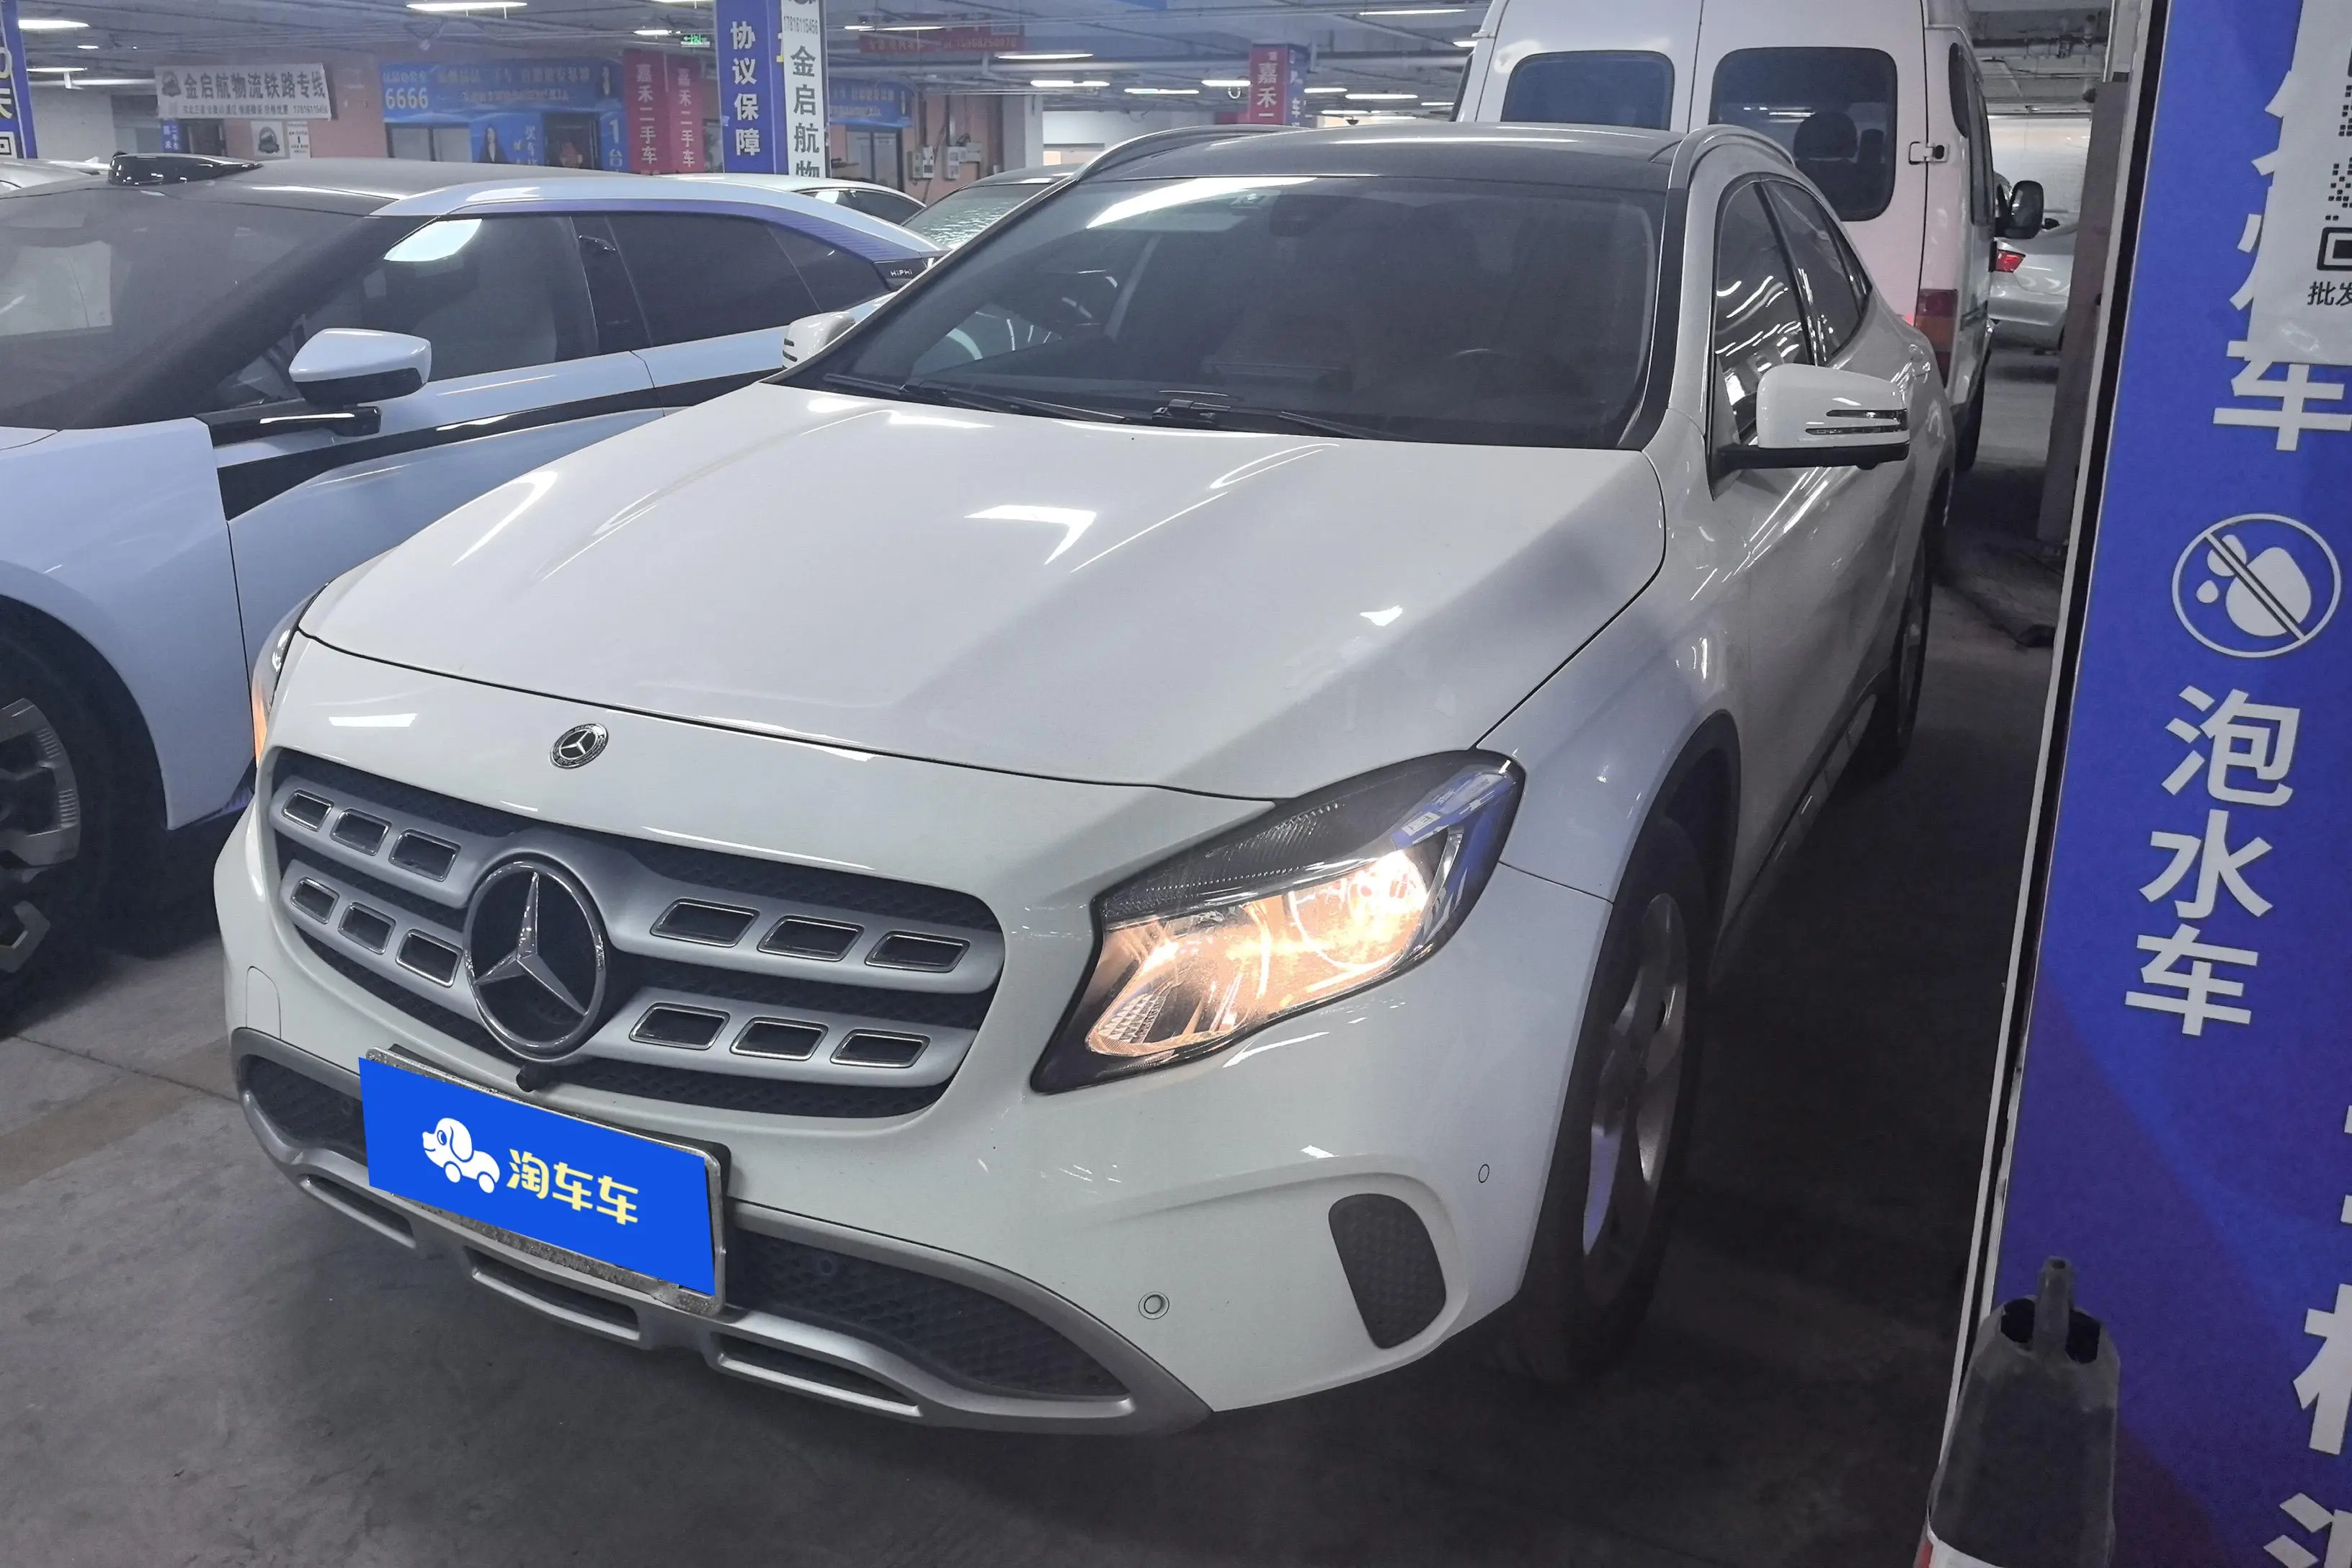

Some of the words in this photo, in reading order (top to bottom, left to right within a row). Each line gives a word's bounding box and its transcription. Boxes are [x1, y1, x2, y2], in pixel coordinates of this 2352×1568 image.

[184, 71, 326, 99] 金启航物流铁路专线
[385, 86, 429, 110] 6666
[636, 63, 658, 164] 嘉禾二手车
[677, 67, 695, 168] 嘉禾二手车
[730, 21, 760, 156] 协议保障
[610, 118, 623, 172] 1台
[2125, 685, 2300, 1036] 泡水车
